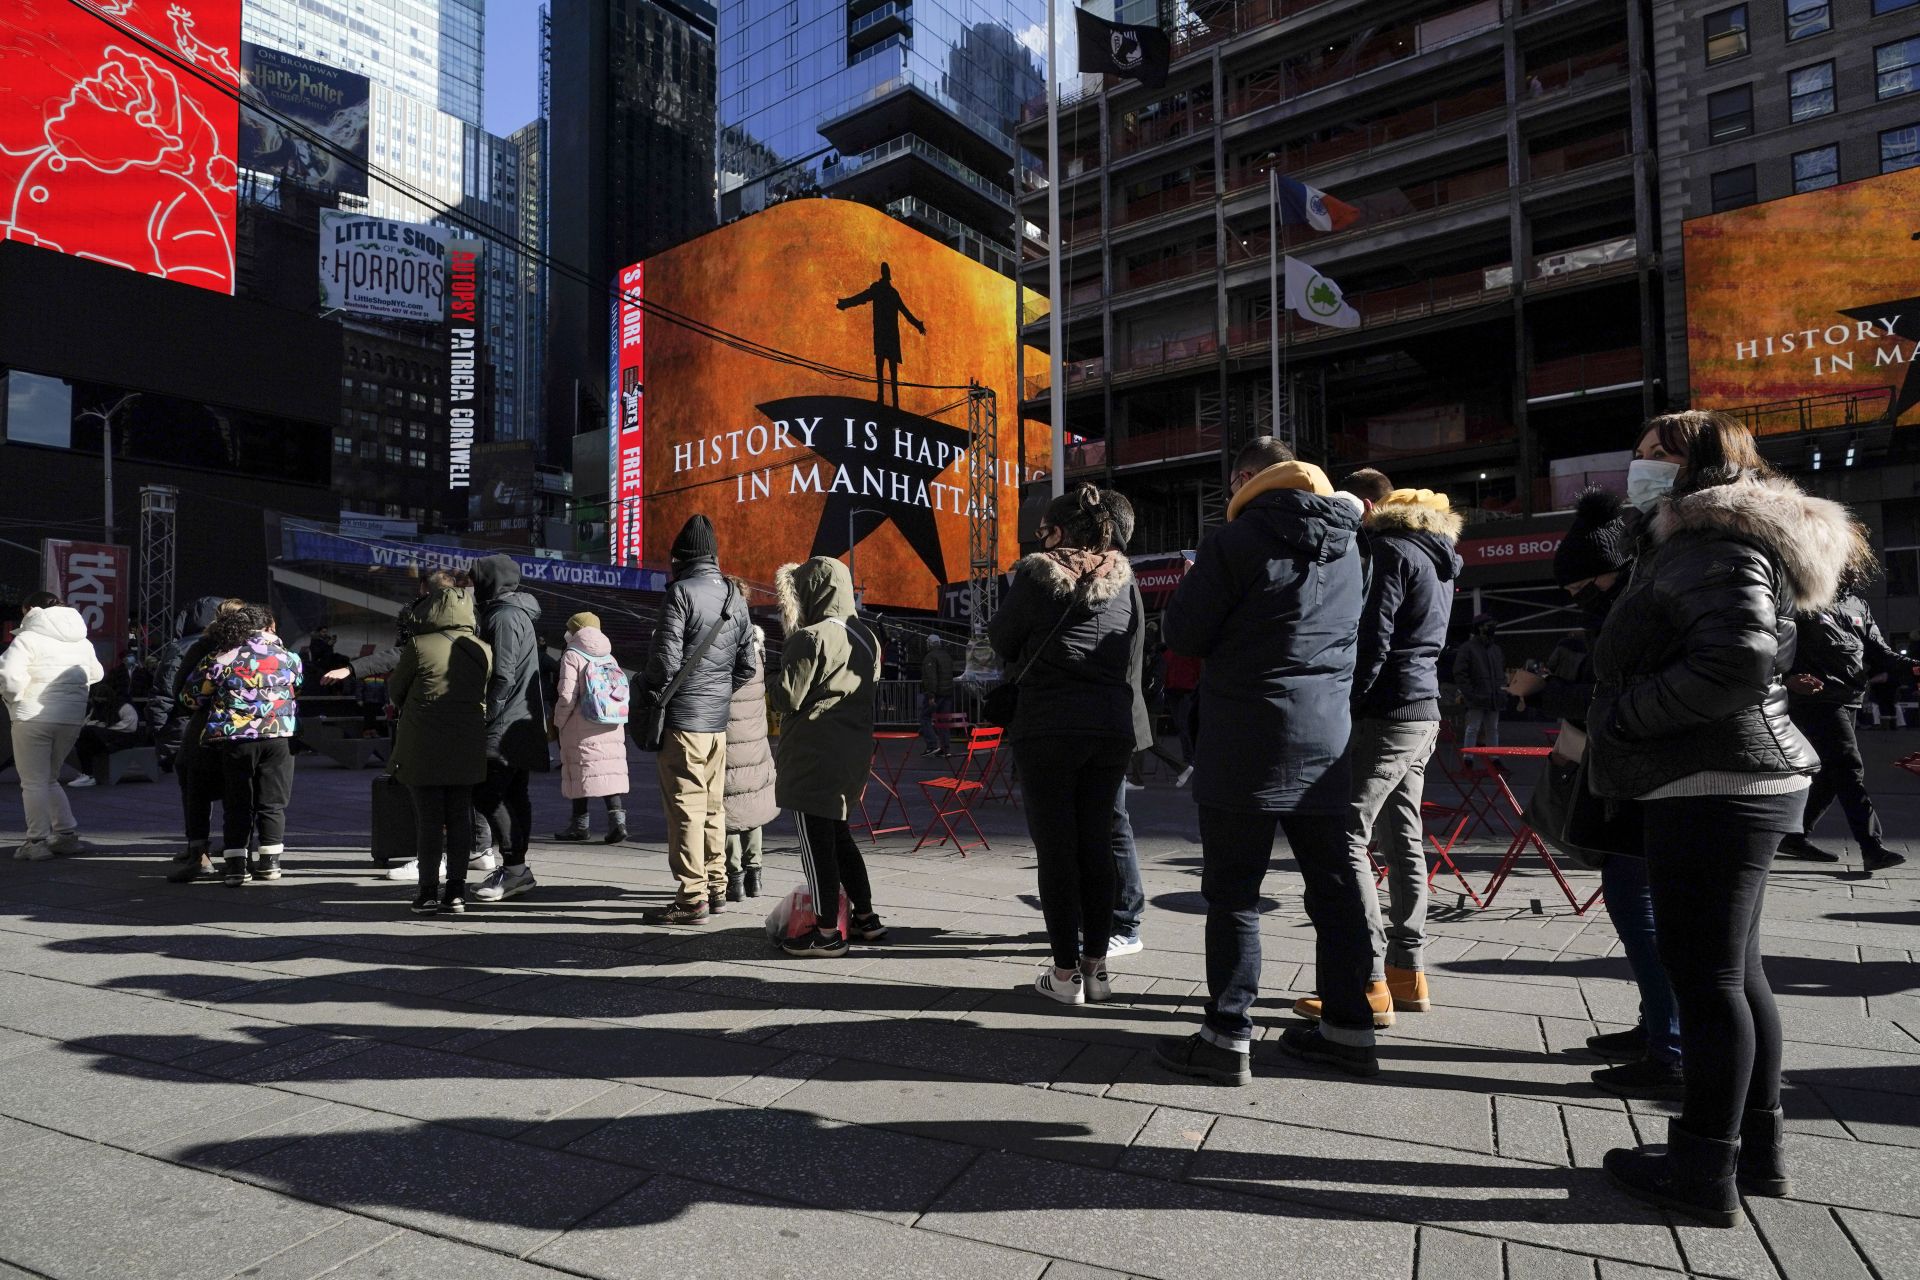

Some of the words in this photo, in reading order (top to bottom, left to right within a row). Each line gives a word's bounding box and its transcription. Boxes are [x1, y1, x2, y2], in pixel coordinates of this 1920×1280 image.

[254, 63, 298, 93] Harry
[299, 72, 344, 105] Potter
[258, 48, 276, 60] ON
[281, 55, 339, 79] BROADWAY
[335, 221, 399, 245] LITTLE
[402, 227, 445, 261] SHOP
[334, 248, 444, 312] HORRORS
[451, 250, 476, 322] AUTOPSY
[353, 294, 424, 310] LittleShopNYC.com
[624, 286, 641, 349] STORE
[1735, 314, 1902, 361] HISTORY
[451, 328, 475, 401] PATRICIA
[1813, 351, 1855, 377] IN
[450, 408, 475, 490] CORNWELL
[673, 417, 824, 473] HISTORY
[843, 421, 878, 451] IS
[623, 446, 641, 491] FREE
[736, 466, 772, 503] IN
[370, 546, 473, 573] WELCOM
[552, 565, 622, 587] WORLD!
[1477, 543, 1514, 558] 1568
[1518, 540, 1561, 555] BROA
[67, 551, 117, 630] tkts
[1136, 573, 1181, 588] ADWAY
